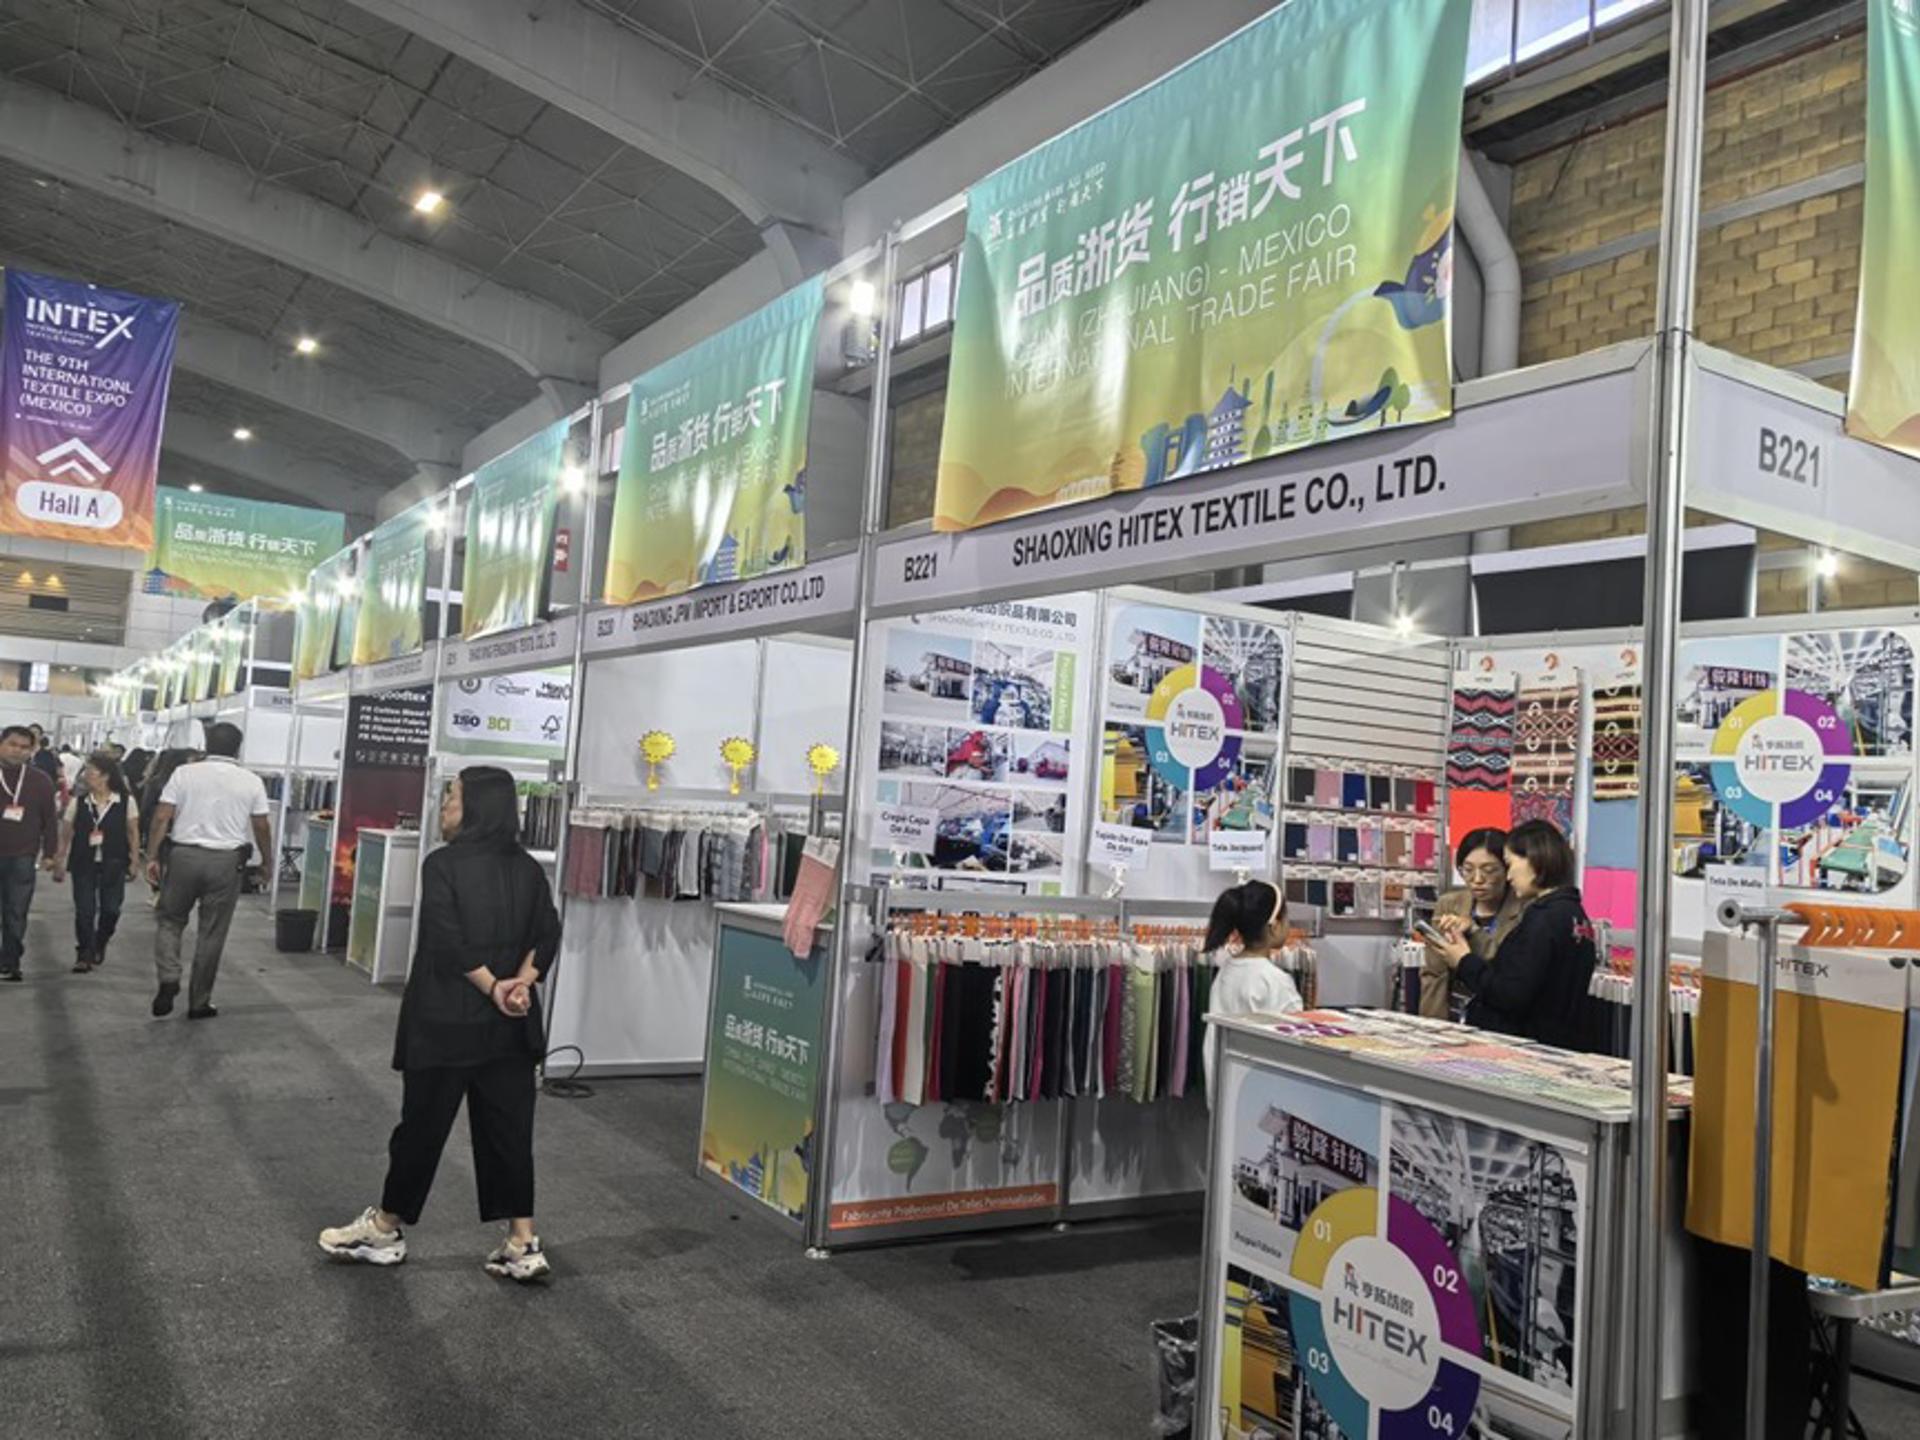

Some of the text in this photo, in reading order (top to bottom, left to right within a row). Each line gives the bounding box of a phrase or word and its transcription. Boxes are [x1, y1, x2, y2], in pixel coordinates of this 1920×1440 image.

[1014, 197, 1155, 318] 品质浙货
[1167, 97, 1367, 252] 行销天下
[1080, 262, 1211, 339] (ZHJIANG)
[1238, 203, 1351, 276] MEXICO
[1187, 275, 1277, 335] TRADE
[1286, 244, 1357, 297] FAIR
[26, 296, 135, 349] INTEX
[24, 348, 89, 371] THE 9TH
[19, 393, 92, 417] (MEXICO)
[22, 378, 126, 408] TEXTILE EXPO
[1758, 427, 1820, 487] B221
[40, 490, 99, 518] Hall A
[1012, 454, 1446, 568] SHAOXING HITEX TEXTILE CO., LTD.
[904, 553, 937, 582] B221
[694, 595, 727, 620] IMPORT
[728, 594, 736, 615] &
[738, 585, 778, 612] EXPORT
[960, 603, 1078, 627] 纺织品有限公司
[453, 713, 480, 727] ISO
[487, 716, 510, 732] BCI
[1171, 722, 1219, 741] HITEX
[1818, 716, 1836, 729] 02
[1745, 755, 1815, 771] HITEX
[1725, 787, 1742, 799] 03
[1815, 790, 1833, 802] 04
[842, 1206, 891, 1222] Fabricante
[1313, 1219, 1331, 1243] 01
[1433, 1265, 1460, 1294] 02
[1334, 1297, 1428, 1365] HITEX
[1308, 1347, 1330, 1375] 03
[1428, 1405, 1454, 1436] 04
